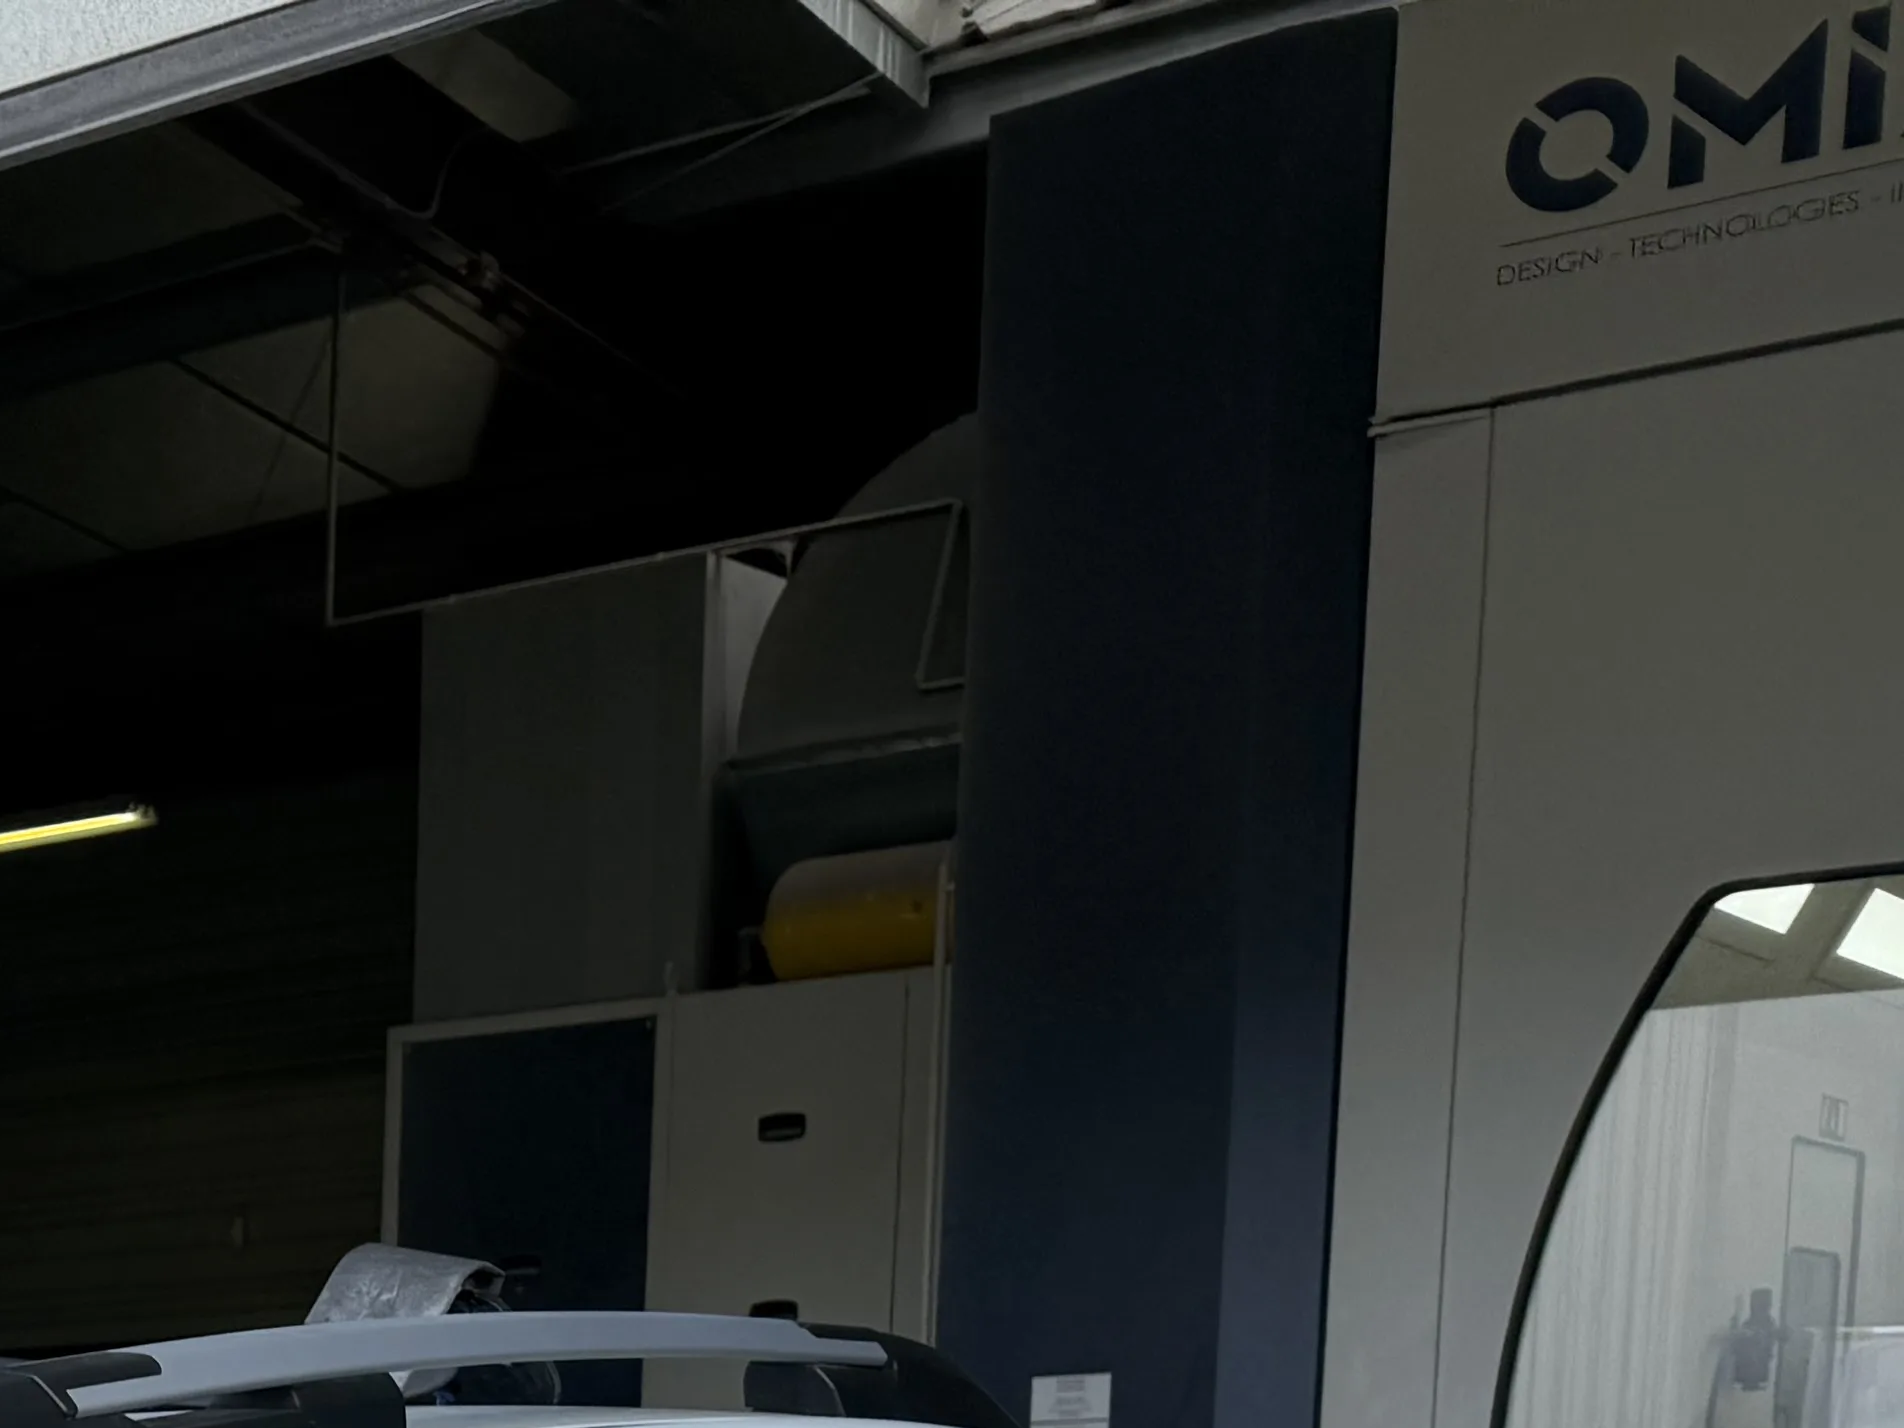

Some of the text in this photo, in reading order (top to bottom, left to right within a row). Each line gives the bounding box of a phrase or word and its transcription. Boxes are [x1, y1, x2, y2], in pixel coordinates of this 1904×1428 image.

[1504, 3, 1904, 213] OMI
[1496, 246, 1604, 287] DESIGN
[1628, 190, 1861, 260] TECHNOLOGIES
